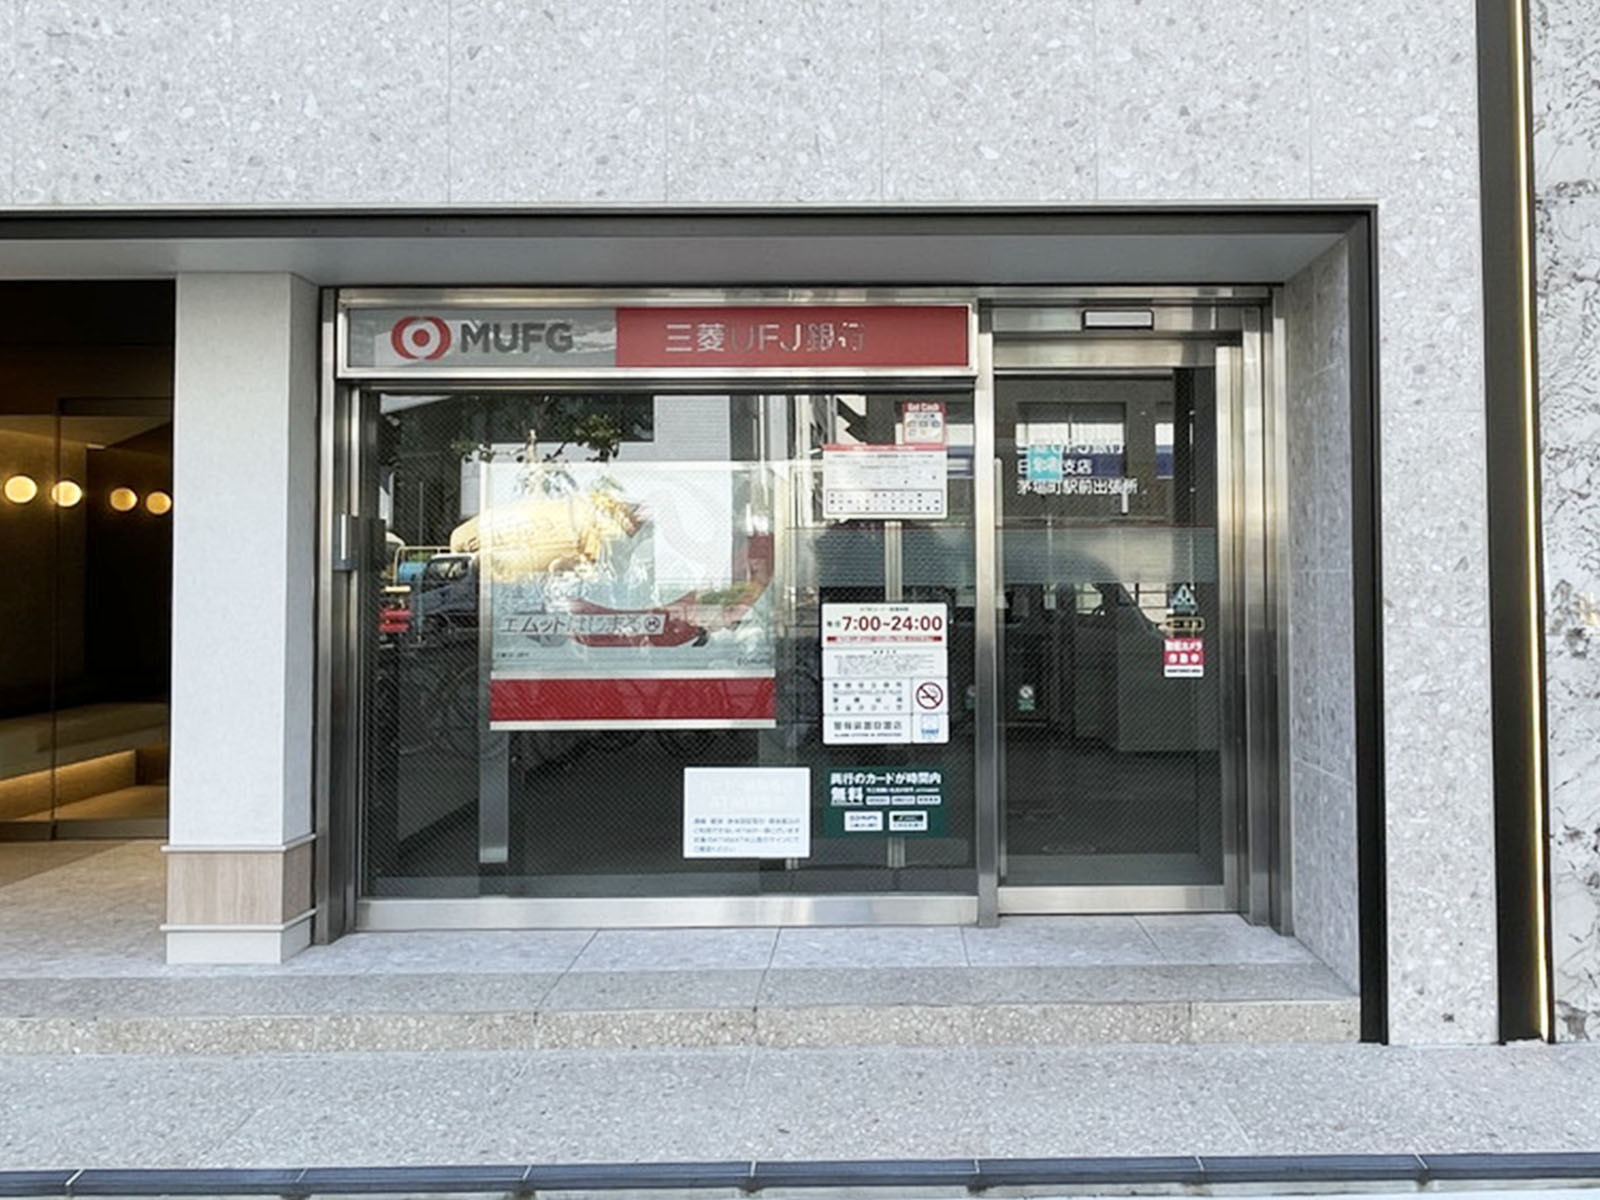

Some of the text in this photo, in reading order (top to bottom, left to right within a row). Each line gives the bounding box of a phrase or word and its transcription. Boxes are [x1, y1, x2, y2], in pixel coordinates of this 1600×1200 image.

[460, 322, 574, 353] MUFG
[665, 322, 866, 352] 三菱UFJ銀行
